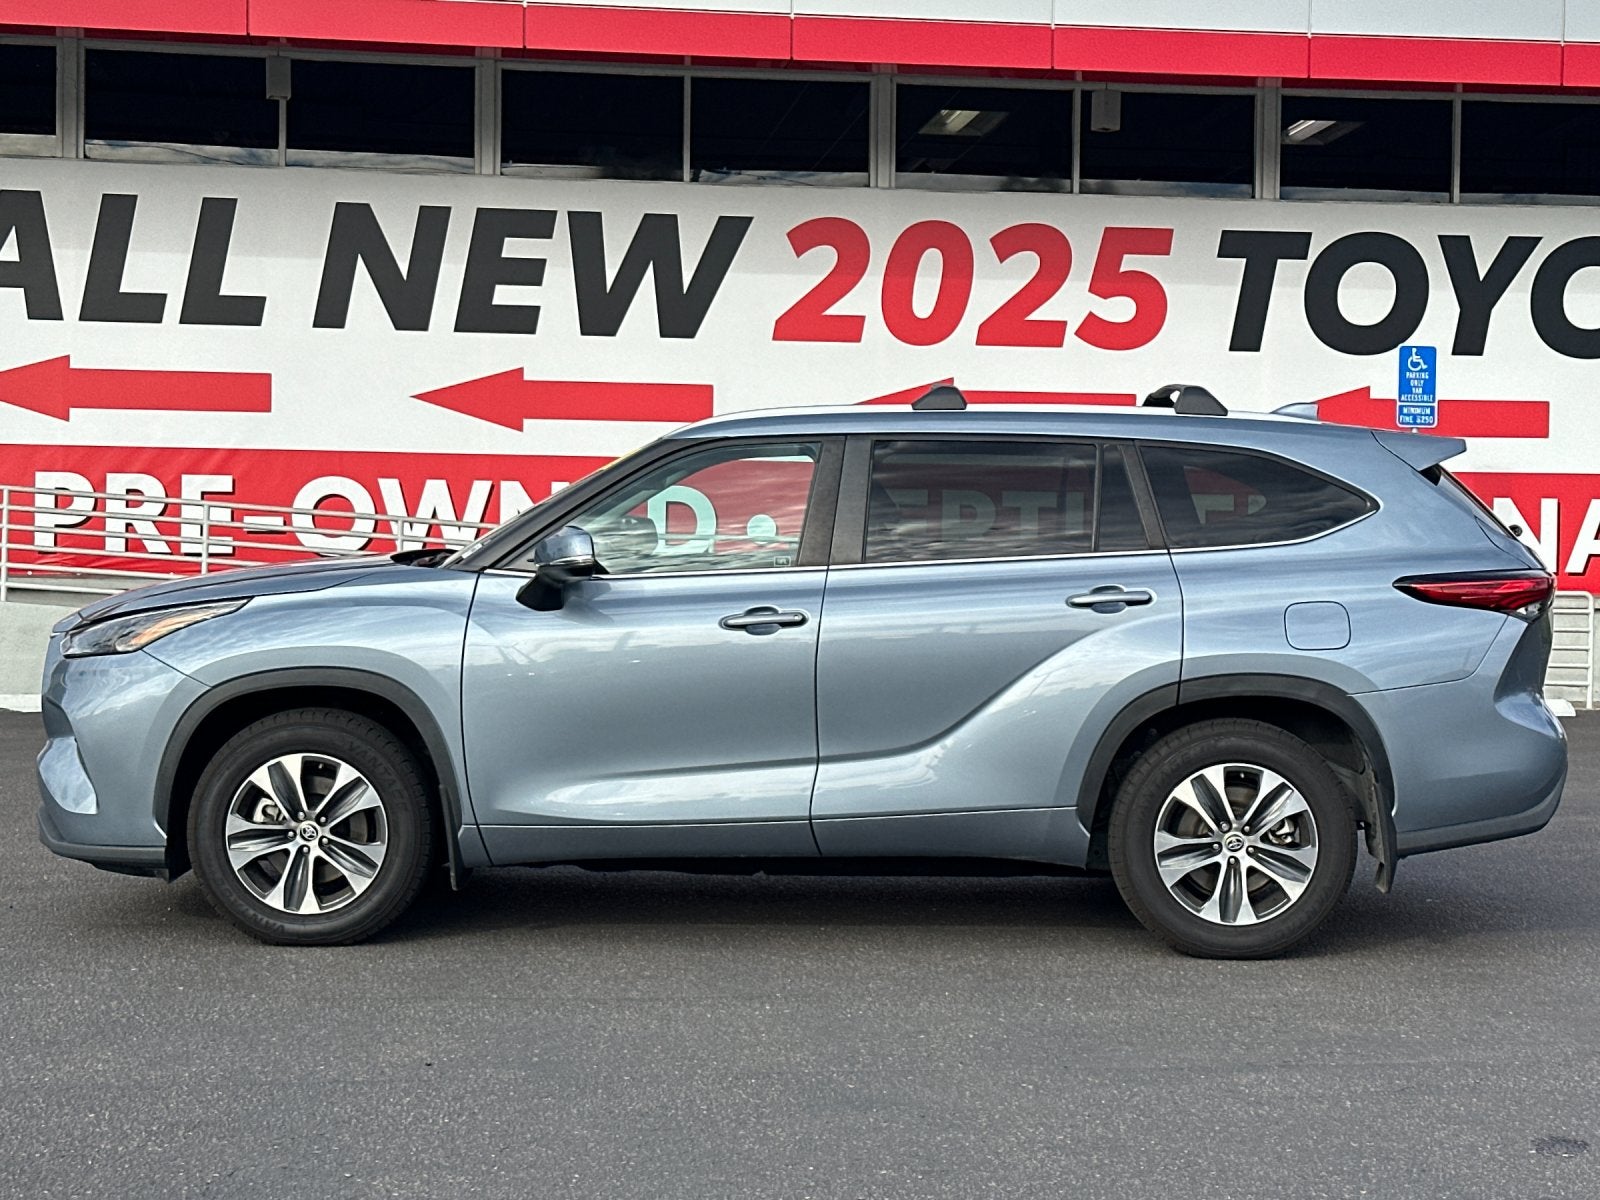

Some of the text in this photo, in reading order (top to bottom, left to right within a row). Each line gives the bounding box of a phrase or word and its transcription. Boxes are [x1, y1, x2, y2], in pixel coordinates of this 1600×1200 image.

[0, 189, 1600, 358] ALL NEW 2025 TOYO
[1406, 371, 1429, 379] PARKING
[1403, 407, 1431, 415] MINIMUM
